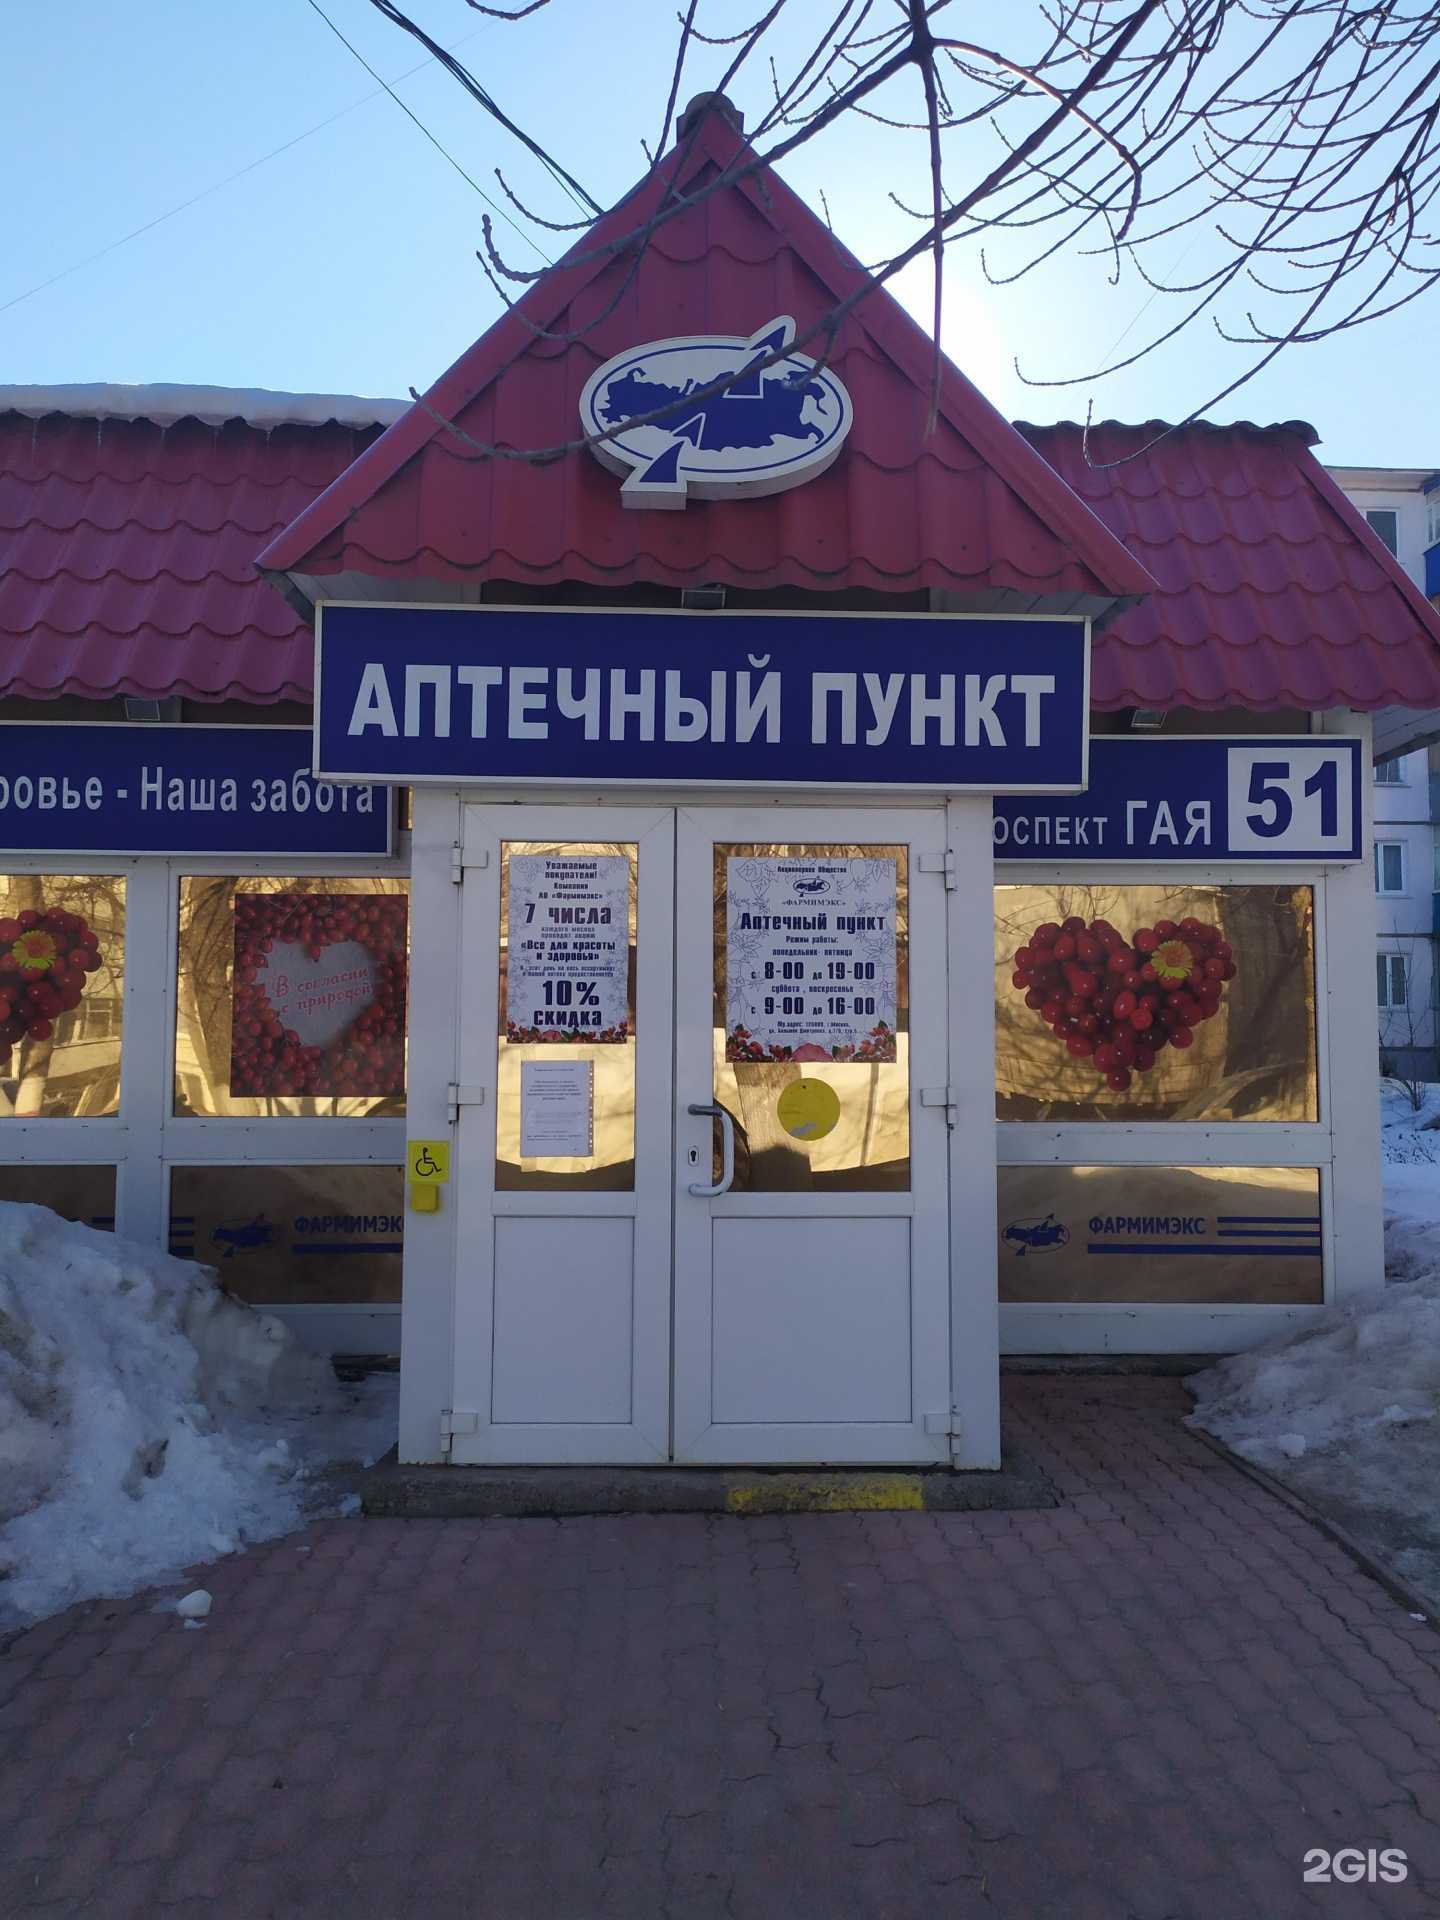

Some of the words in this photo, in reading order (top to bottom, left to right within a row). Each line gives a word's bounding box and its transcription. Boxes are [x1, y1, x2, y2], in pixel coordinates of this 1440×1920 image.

[347, 653, 782, 744] АПТЕЧНЫЙ
[811, 672, 1055, 747] ПУНКТ
[141, 766, 237, 811] Наша
[250, 768, 373, 812] забота
[992, 815, 1108, 845] ОСПЕКТ
[1126, 800, 1211, 845] ГАЯ
[1246, 761, 1338, 838] 51
[545, 861, 598, 870] Уважаемые
[545, 871, 598, 880] покупатели!
[524, 903, 536, 924] 7
[548, 907, 612, 924] числа
[740, 912, 827, 931] Аптечный
[836, 916, 886, 934] пункт
[521, 940, 545, 950] «Все
[550, 940, 568, 951] для
[573, 940, 616, 952] красоты
[785, 936, 809, 944] Режим
[547, 952, 600, 963] здоровья»
[764, 961, 805, 980] 8-00
[812, 971, 822, 981] до
[827, 961, 875, 980] 19-00
[275, 975, 288, 997] В
[297, 967, 369, 993] согласии
[771, 985, 800, 994] суббота
[296, 982, 371, 1015] природой
[542, 980, 600, 1006] 10%
[764, 997, 805, 1015] 9-00
[812, 1006, 822, 1016] до
[827, 997, 875, 1015] 16-00
[533, 1010, 602, 1028] скидка
[295, 1215, 405, 1233] ФАРМИМЭК
[1089, 1216, 1206, 1234] ФАРМИМЭКС
